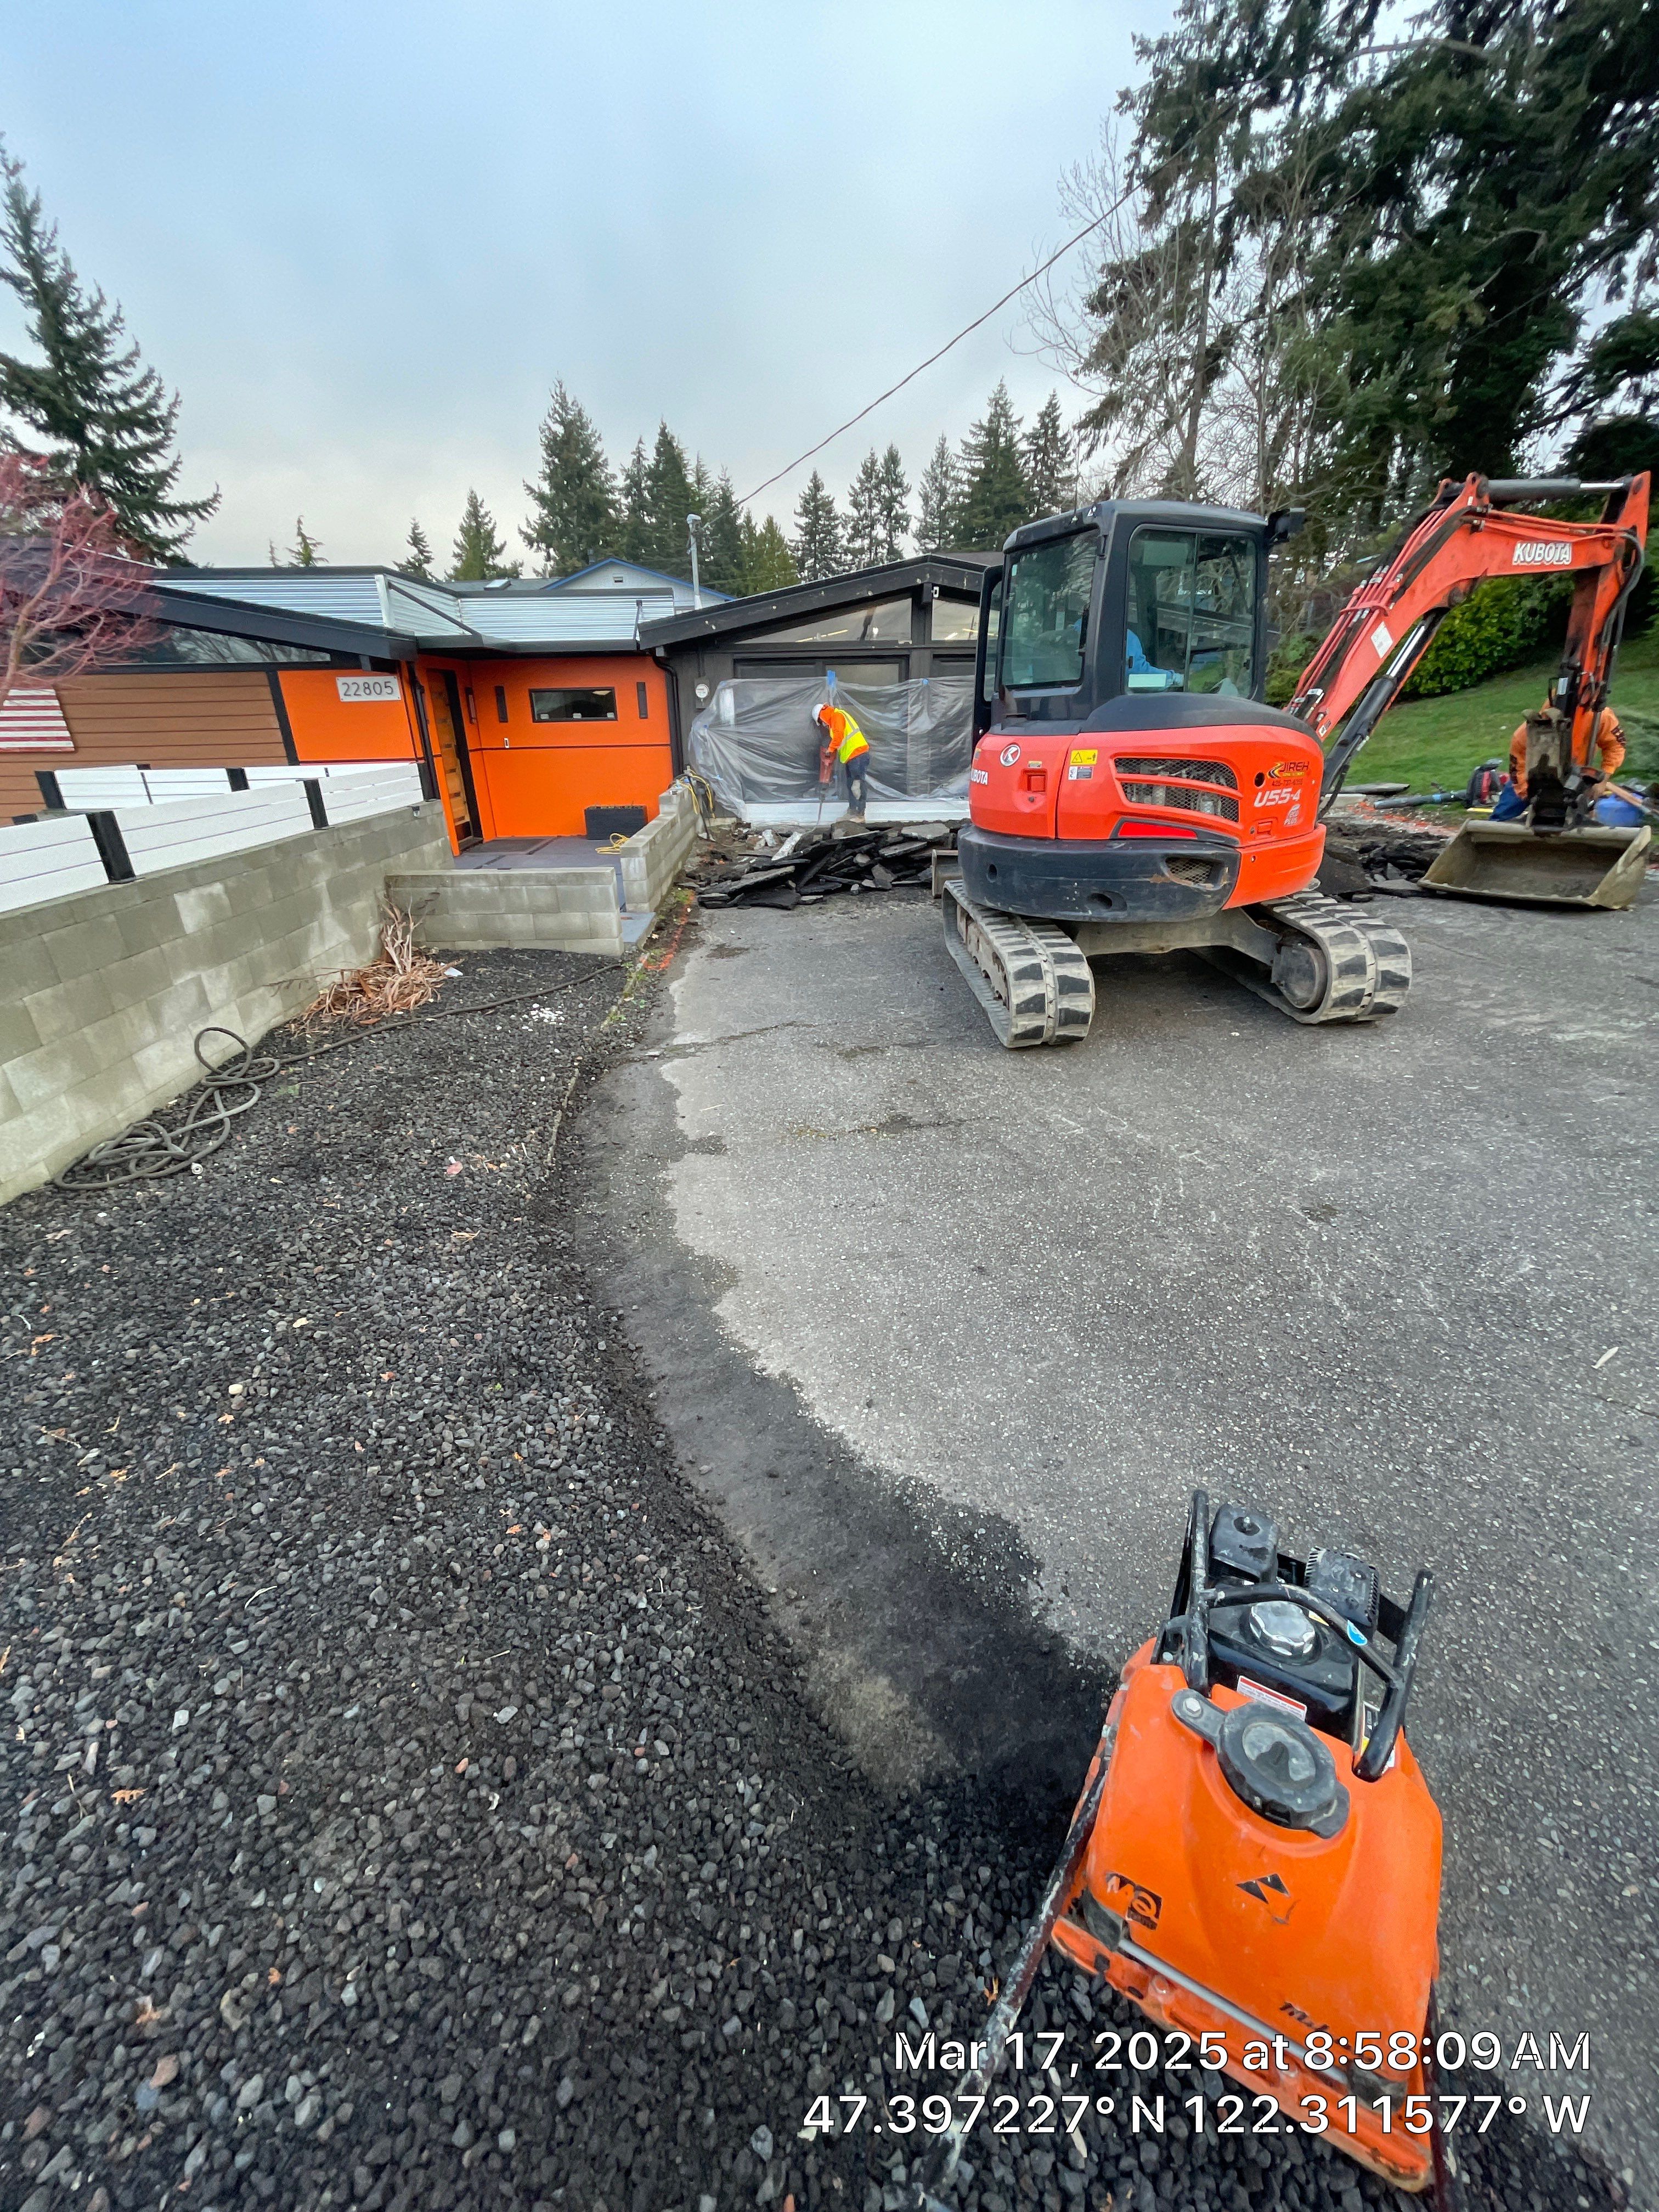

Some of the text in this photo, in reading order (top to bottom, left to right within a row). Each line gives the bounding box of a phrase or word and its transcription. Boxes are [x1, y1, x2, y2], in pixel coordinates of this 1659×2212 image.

[1513, 541, 1572, 566] KUBOTA
[342, 681, 394, 697] 22805
[1279, 761, 1310, 772] JIREH
[1254, 788, 1301, 808] U55-4
